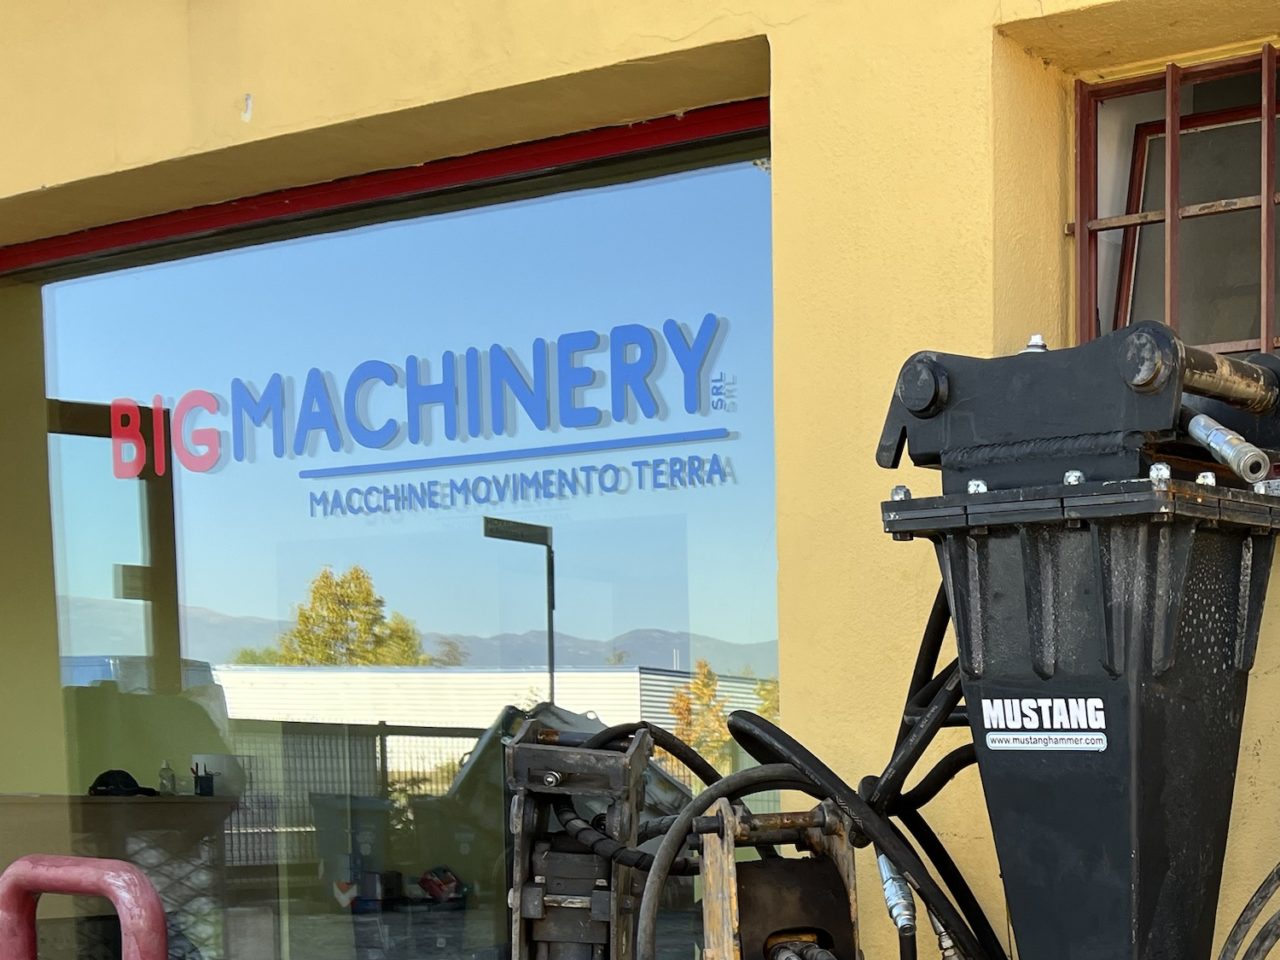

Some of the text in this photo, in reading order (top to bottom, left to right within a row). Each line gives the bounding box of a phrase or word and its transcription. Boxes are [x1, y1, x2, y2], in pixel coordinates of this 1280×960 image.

[712, 371, 724, 410] SRL
[309, 454, 727, 518] MACCHINE MOVIMENTO TERRA
[981, 698, 1107, 730] MUSTANG
[990, 735, 1104, 747] www.mustanghammer.com
